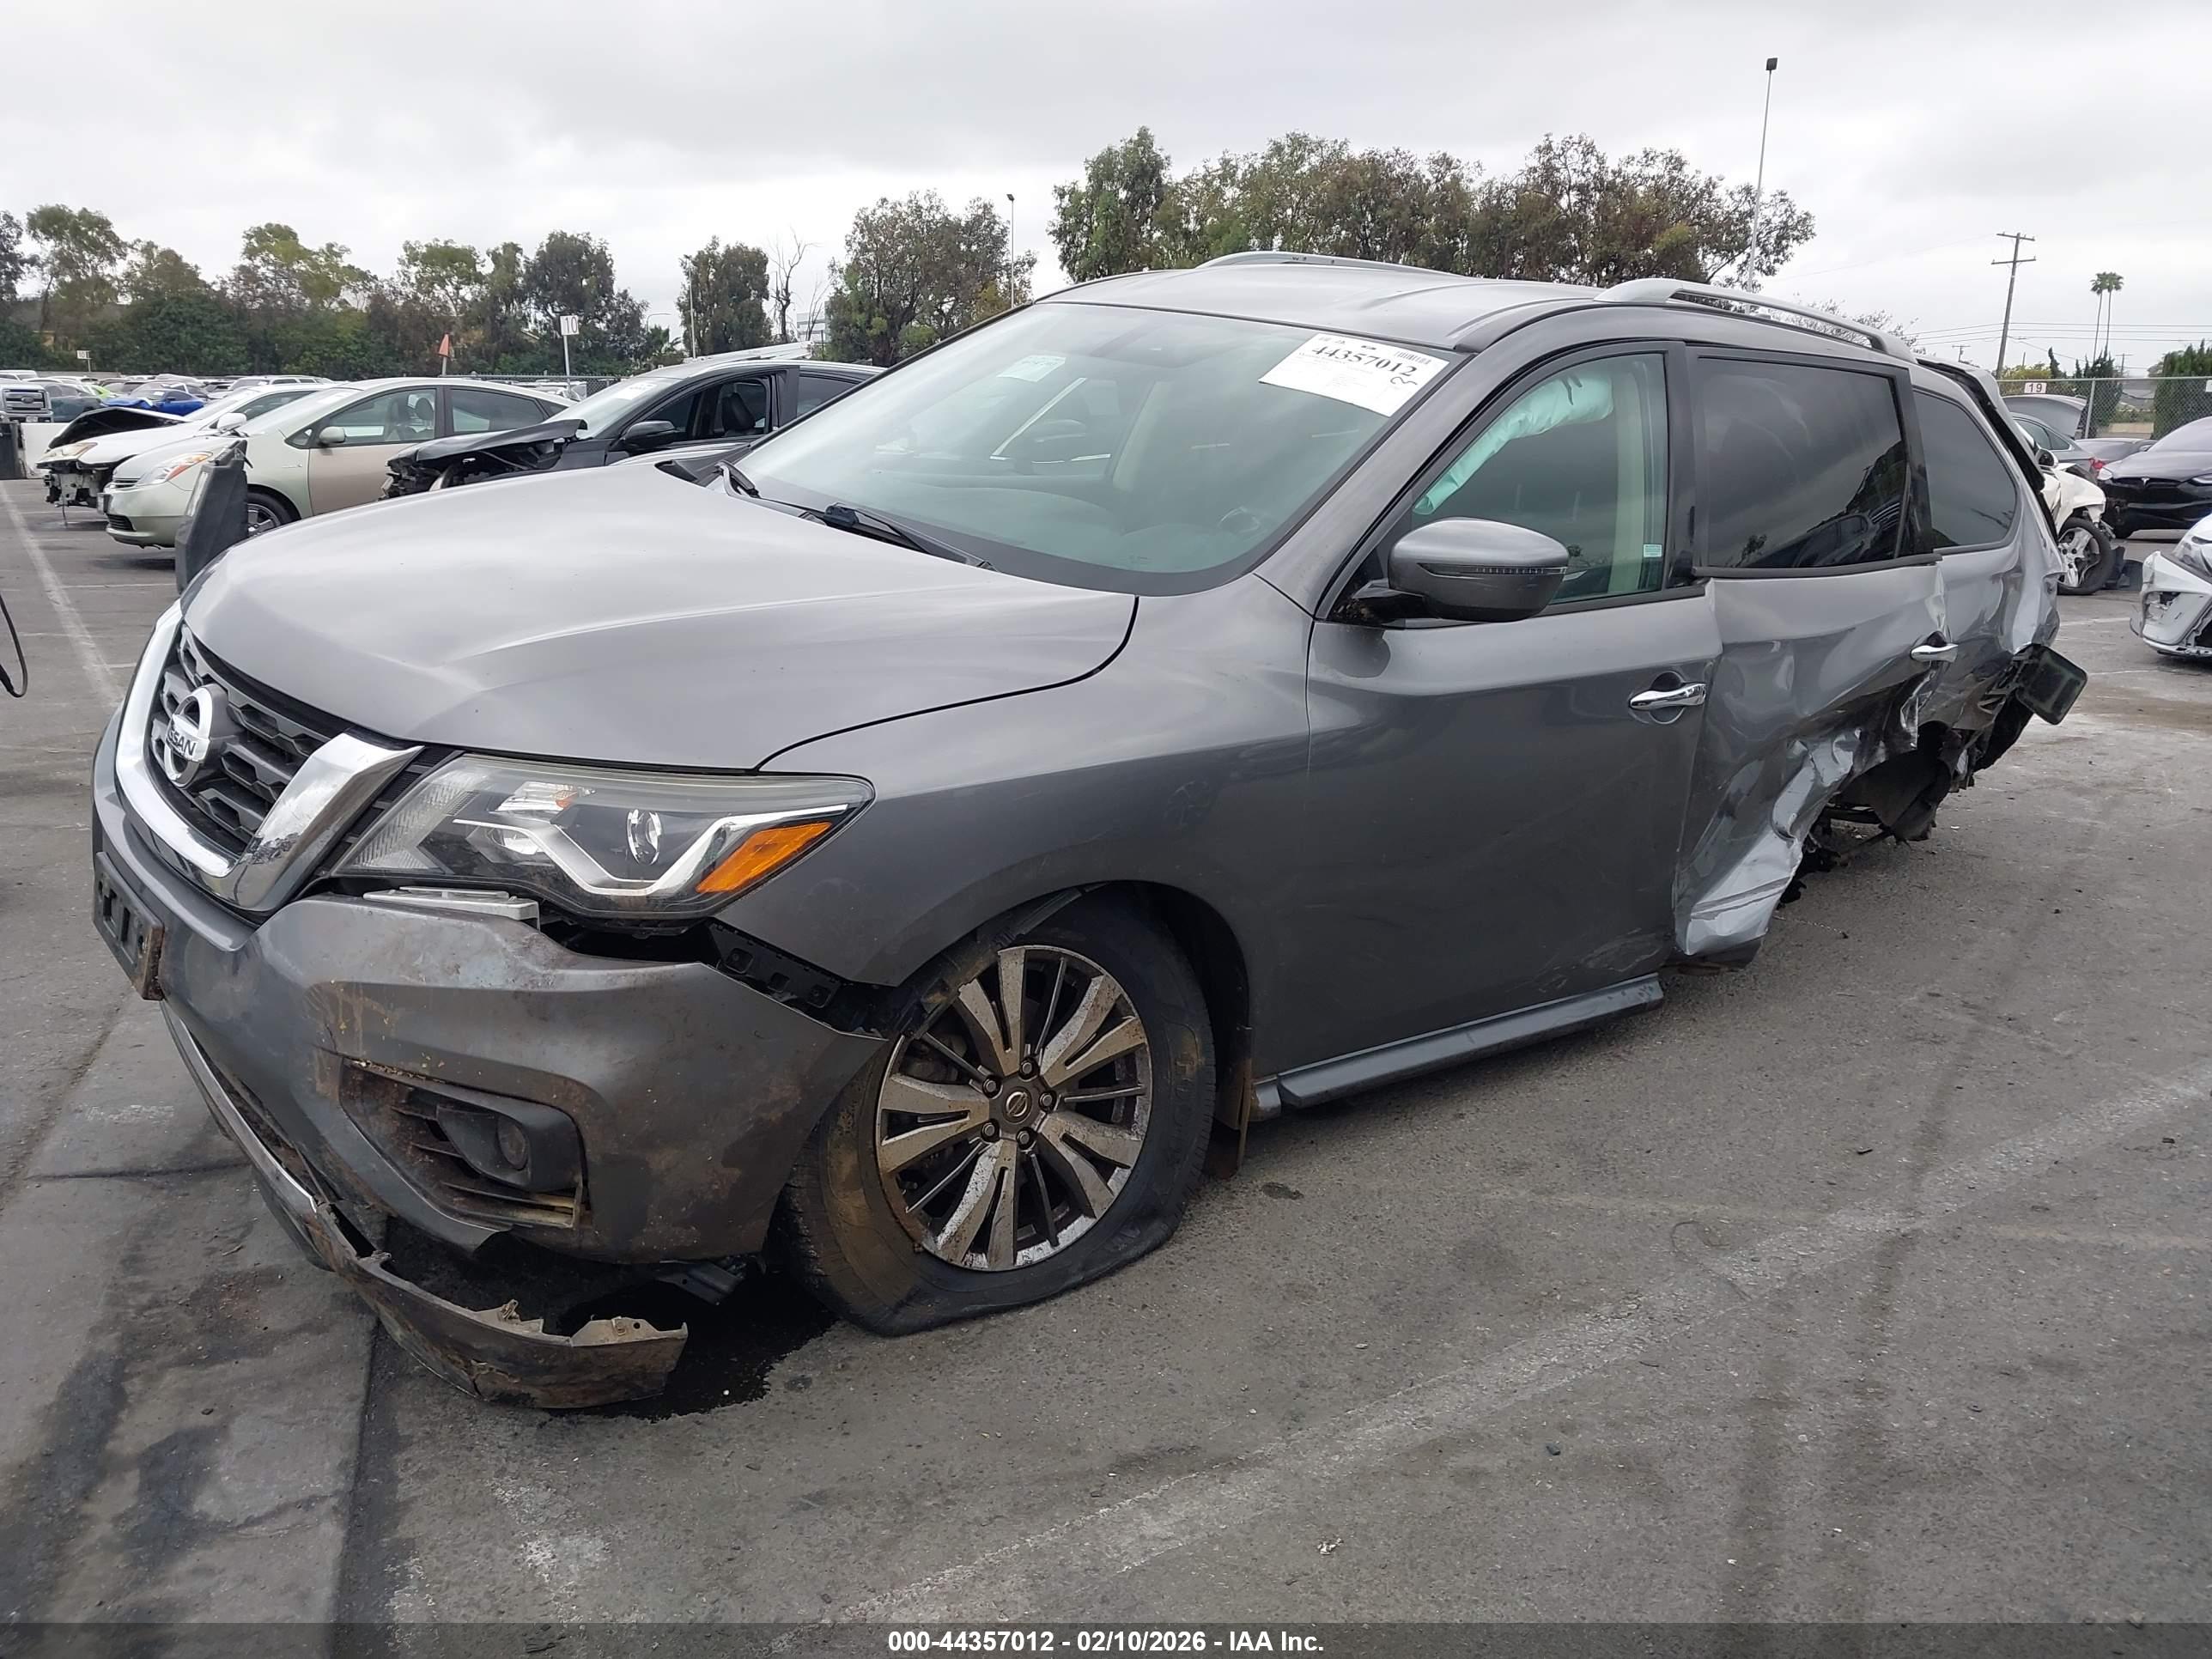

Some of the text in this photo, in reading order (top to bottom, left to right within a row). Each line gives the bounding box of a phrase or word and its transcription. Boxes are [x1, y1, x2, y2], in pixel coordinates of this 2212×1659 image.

[565, 316, 578, 334] 10
[1311, 345, 1418, 376] 44357012
[2028, 383, 2043, 392] 19
